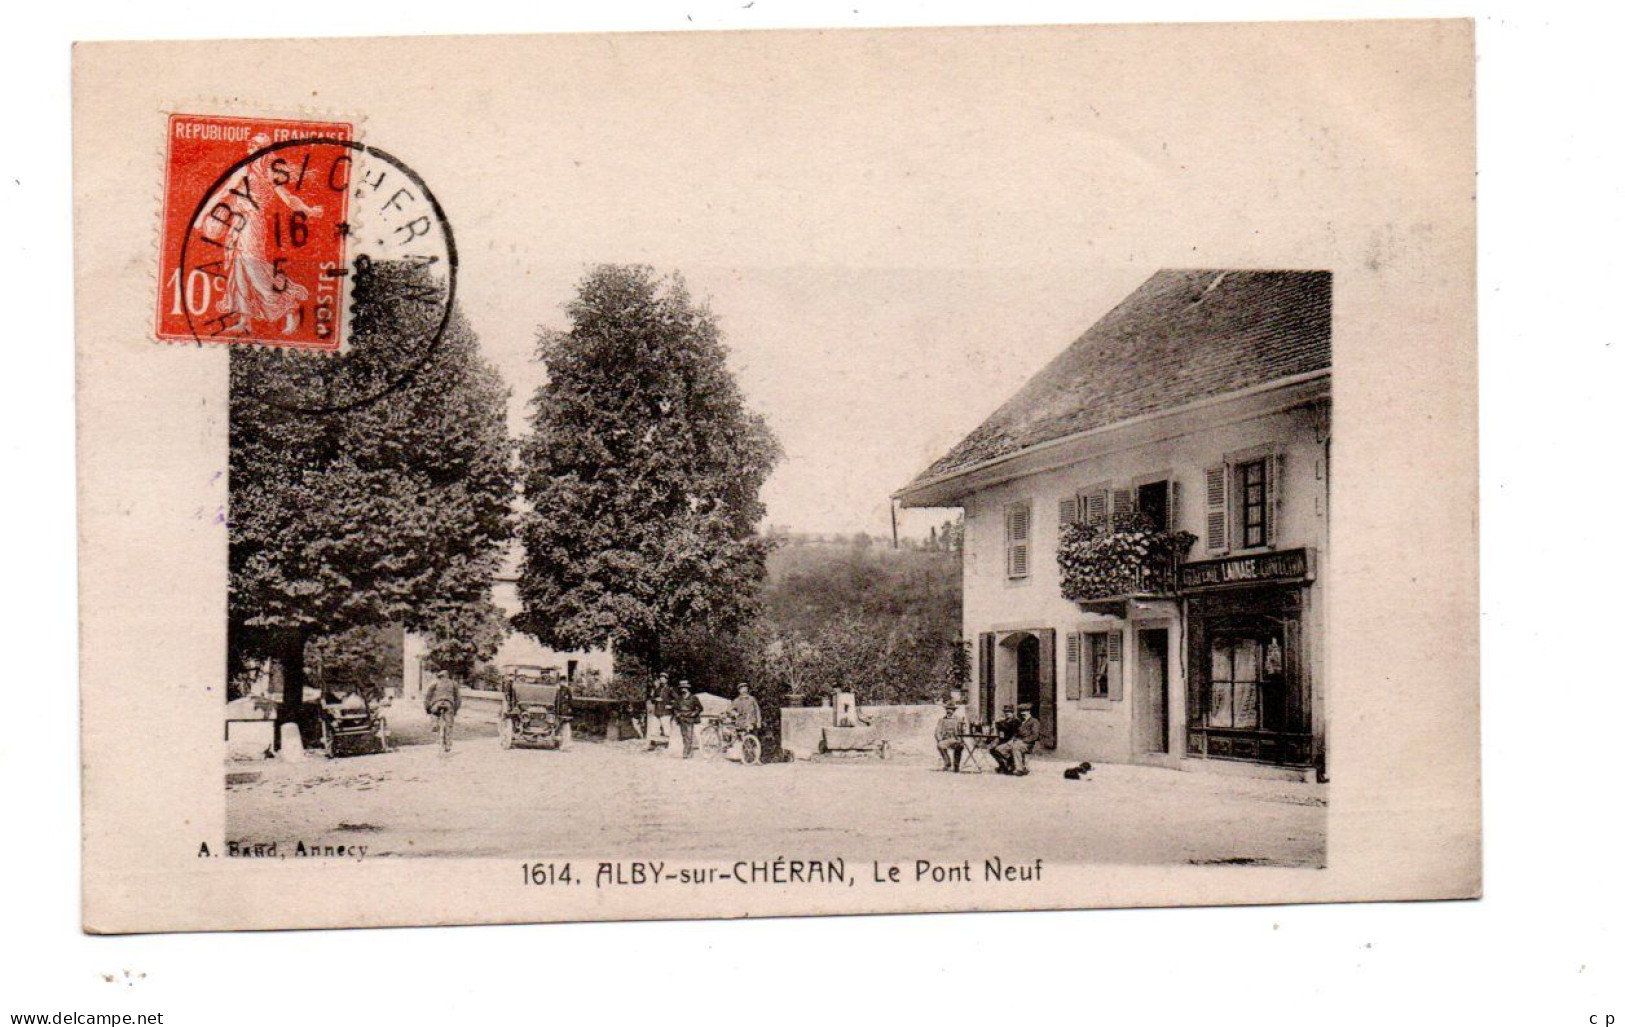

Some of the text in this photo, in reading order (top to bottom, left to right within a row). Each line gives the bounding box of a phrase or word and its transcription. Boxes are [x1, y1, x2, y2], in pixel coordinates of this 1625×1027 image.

[197, 841, 219, 858] A.
[294, 840, 369, 862] Annecy
[522, 862, 581, 886] 1614.
[874, 861, 901, 884] Le
[915, 859, 972, 883] Pont
[985, 856, 1043, 883] Neuf
